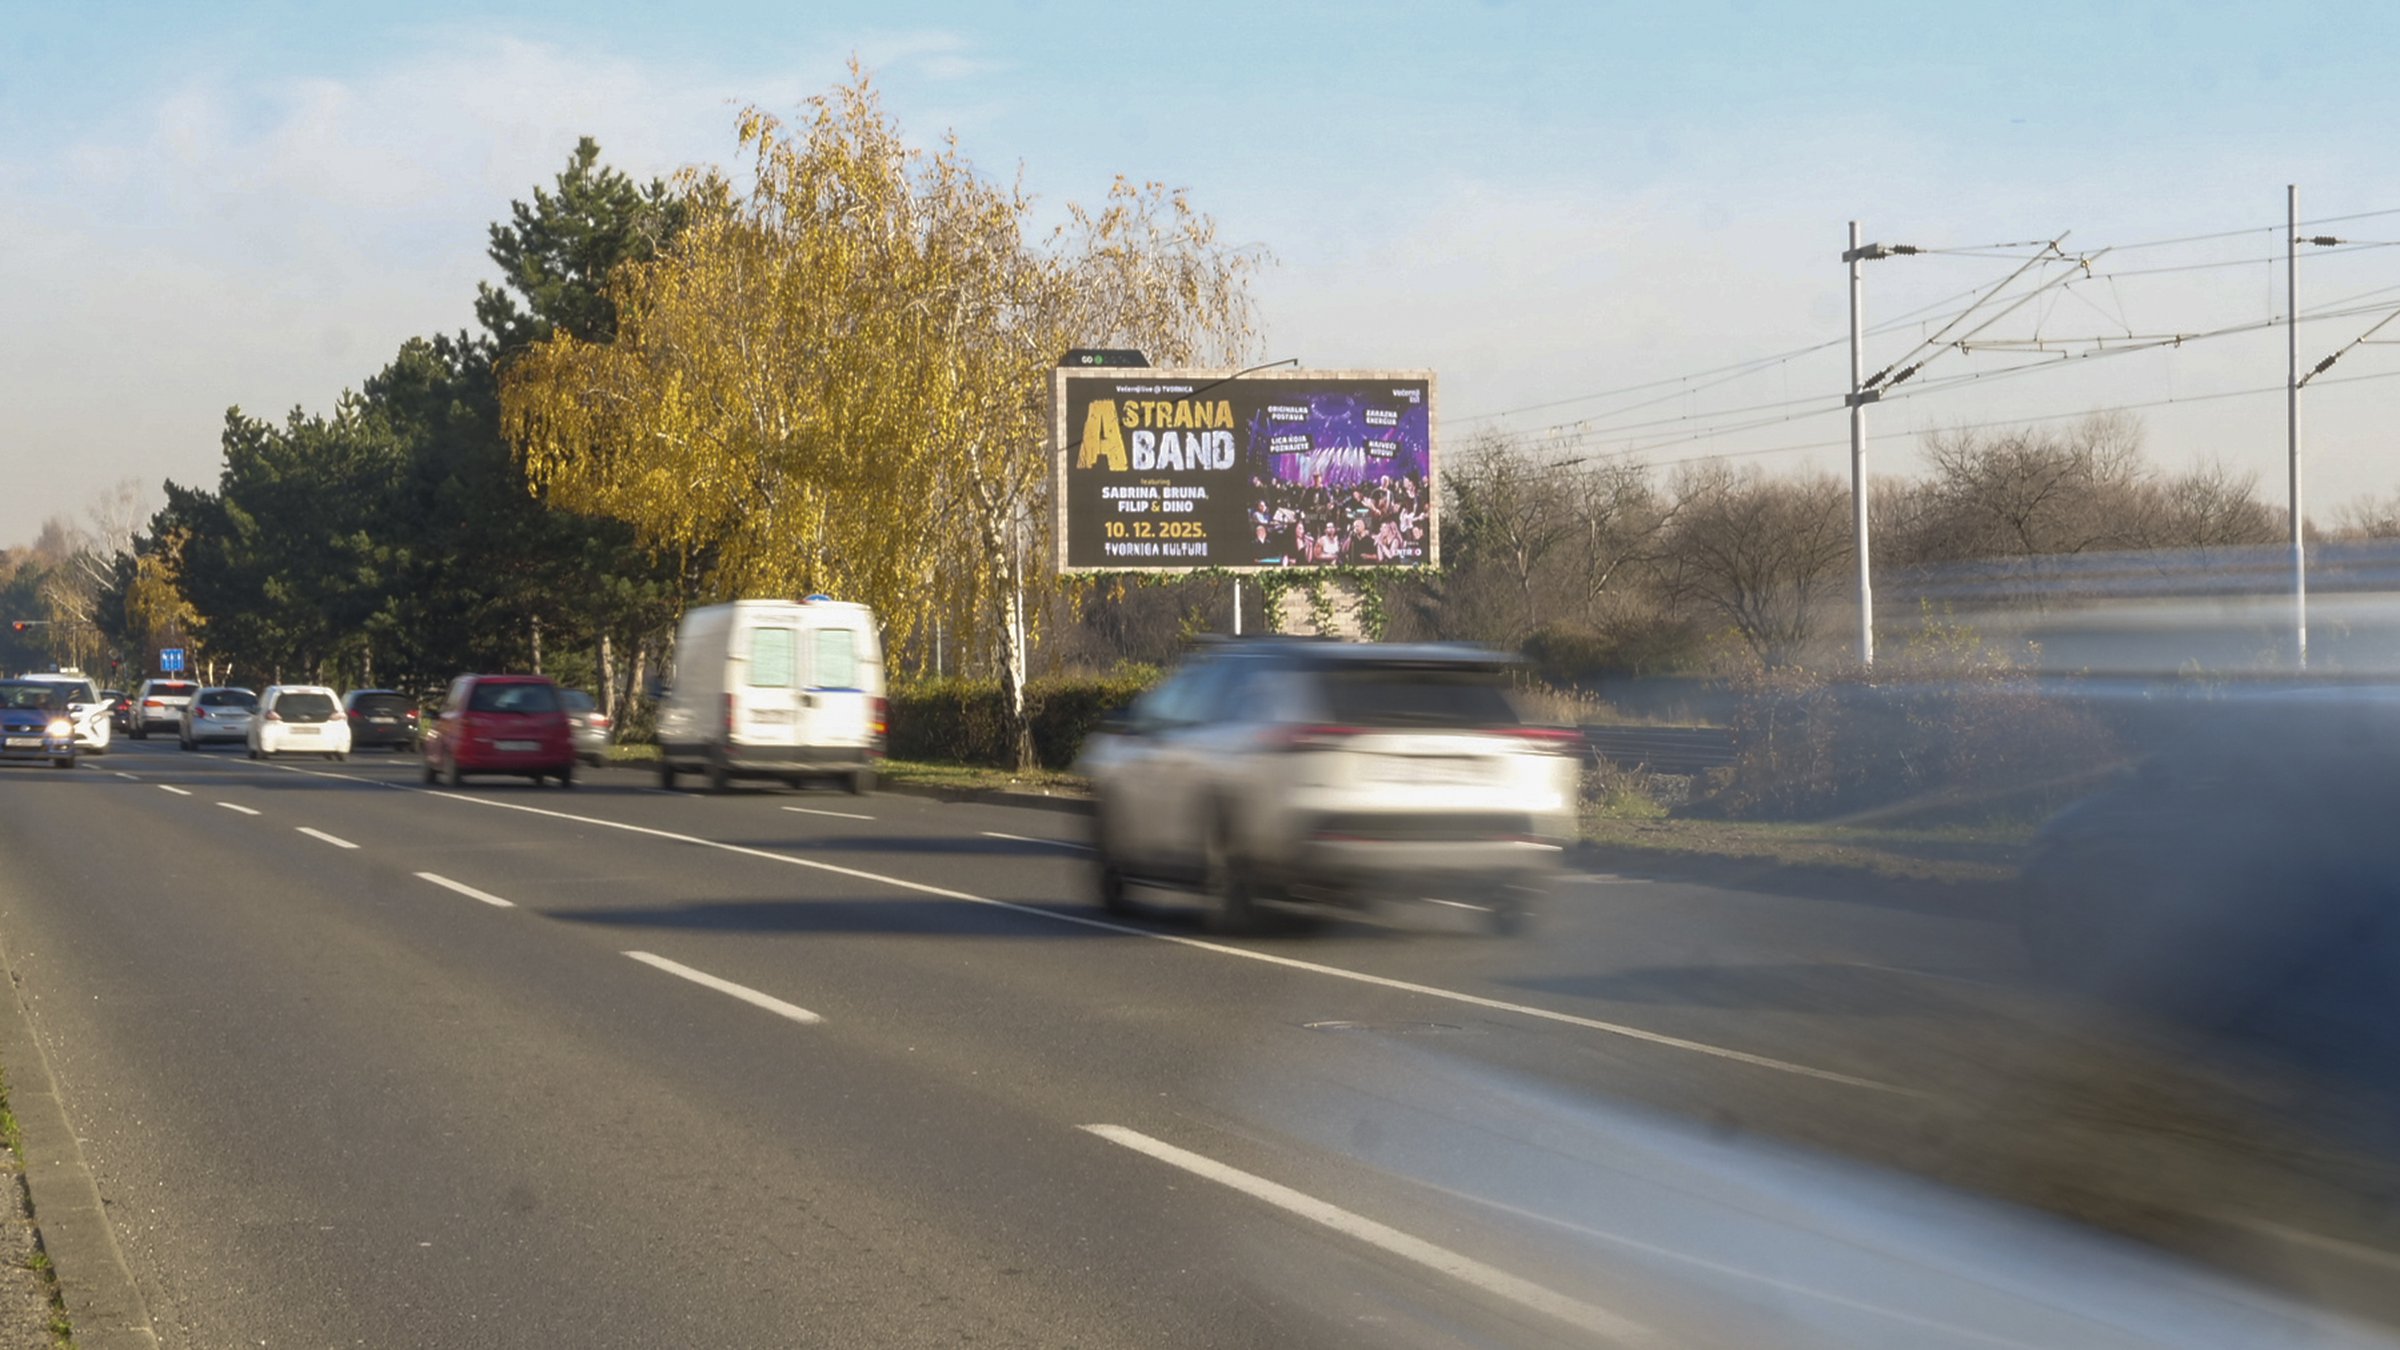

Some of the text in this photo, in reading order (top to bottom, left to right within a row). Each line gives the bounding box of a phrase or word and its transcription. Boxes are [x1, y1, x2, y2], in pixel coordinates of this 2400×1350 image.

[1122, 399, 1234, 429] STRANA
[1267, 405, 1308, 414] ORIGINALNA
[1272, 413, 1304, 421] POSTAVA
[1076, 398, 1128, 471] A
[1270, 435, 1307, 445] LICA KOJA
[1132, 430, 1235, 471] BAND
[1270, 442, 1309, 453] POZNAJETE
[1140, 478, 1171, 486] featuring
[1102, 486, 1209, 500] SABRINA, BRUNA,
[1118, 500, 1194, 513] FILIP & DINO
[1104, 521, 1207, 538] 10. 12. 2025.
[1104, 542, 1159, 557] TVORNICA
